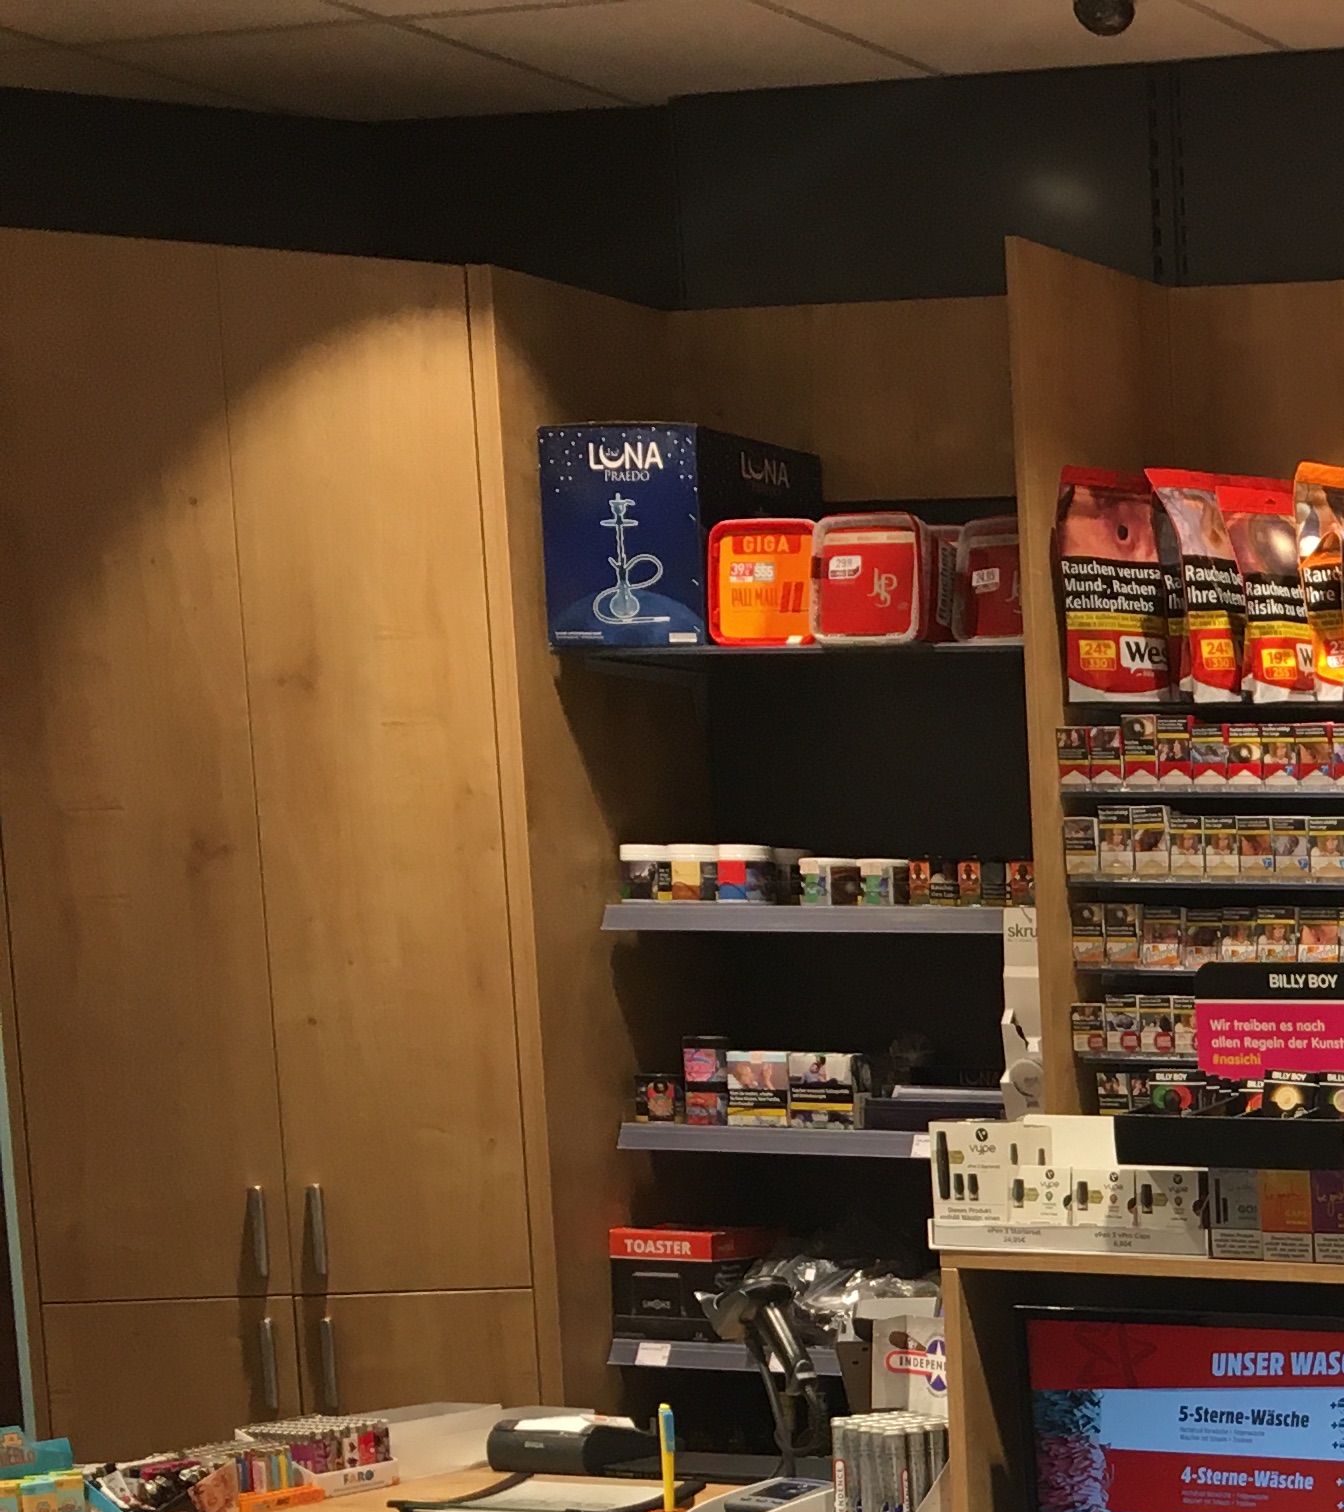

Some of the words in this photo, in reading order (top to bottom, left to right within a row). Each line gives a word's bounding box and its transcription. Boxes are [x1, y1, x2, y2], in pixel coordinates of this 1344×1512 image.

[589, 442, 663, 470] LUNA
[605, 469, 650, 482] PRAEDO
[743, 536, 789, 553] GIGA
[1062, 561, 1113, 576] Rauchen
[1064, 579, 1110, 595] Mund-,
[1113, 580, 1156, 595] Rachen
[1065, 594, 1154, 612] Kehlkopfkrebs
[1269, 974, 1305, 989] BILLY
[1307, 974, 1338, 989] BOY
[1209, 1019, 1231, 1032] Wir
[1234, 1018, 1275, 1033] treiben
[1279, 1021, 1293, 1033] es
[1297, 1020, 1325, 1033] nach
[1211, 1037, 1241, 1050] allen
[1244, 1036, 1285, 1052] Regeln
[1288, 1036, 1310, 1050] der
[1212, 1052, 1262, 1067] #nasichi
[624, 1238, 691, 1256] TOASTER
[1211, 1351, 1284, 1378] UNSER
[1178, 1404, 1310, 1430] 5-Sterne-Wäsche
[1180, 1465, 1315, 1492] 4-Sterne-Wäsche
